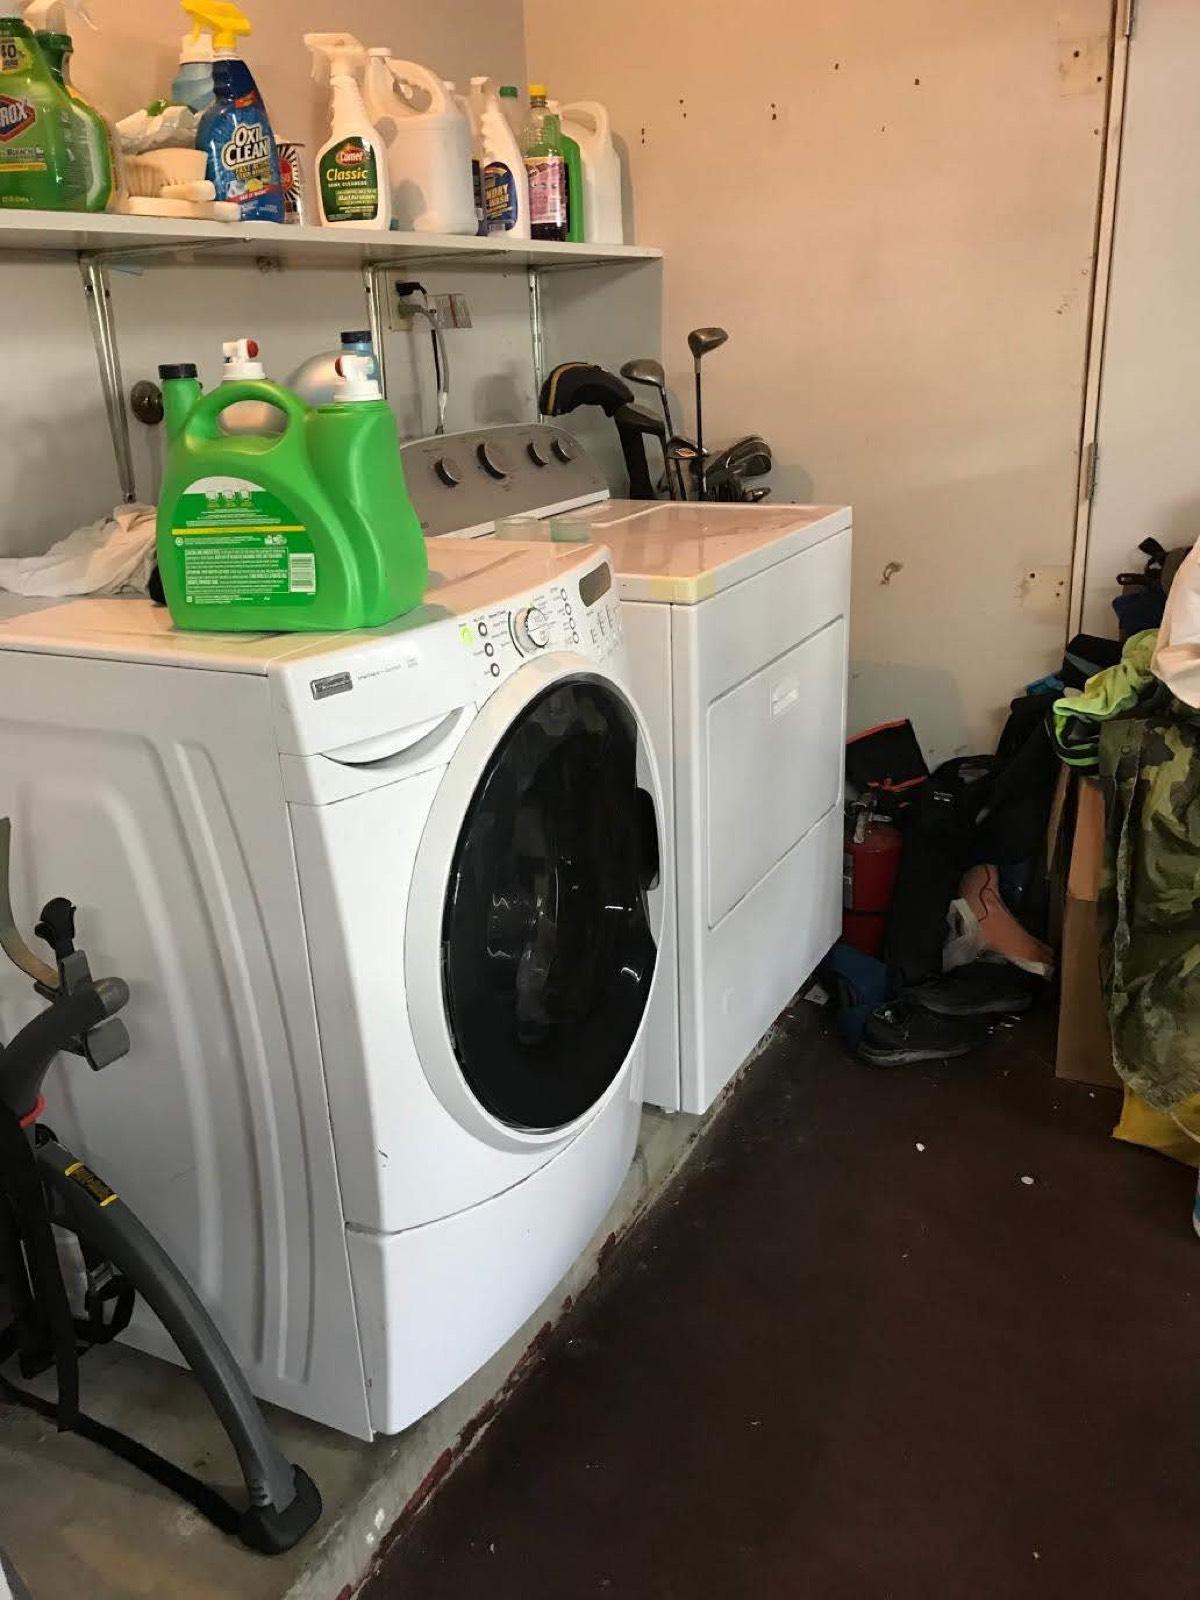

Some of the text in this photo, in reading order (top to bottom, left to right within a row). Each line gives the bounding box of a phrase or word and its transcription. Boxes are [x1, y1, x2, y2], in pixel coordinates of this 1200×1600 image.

[235, 126, 260, 147] OXI
[224, 140, 270, 167] CLEAN
[326, 167, 369, 181] Classic
